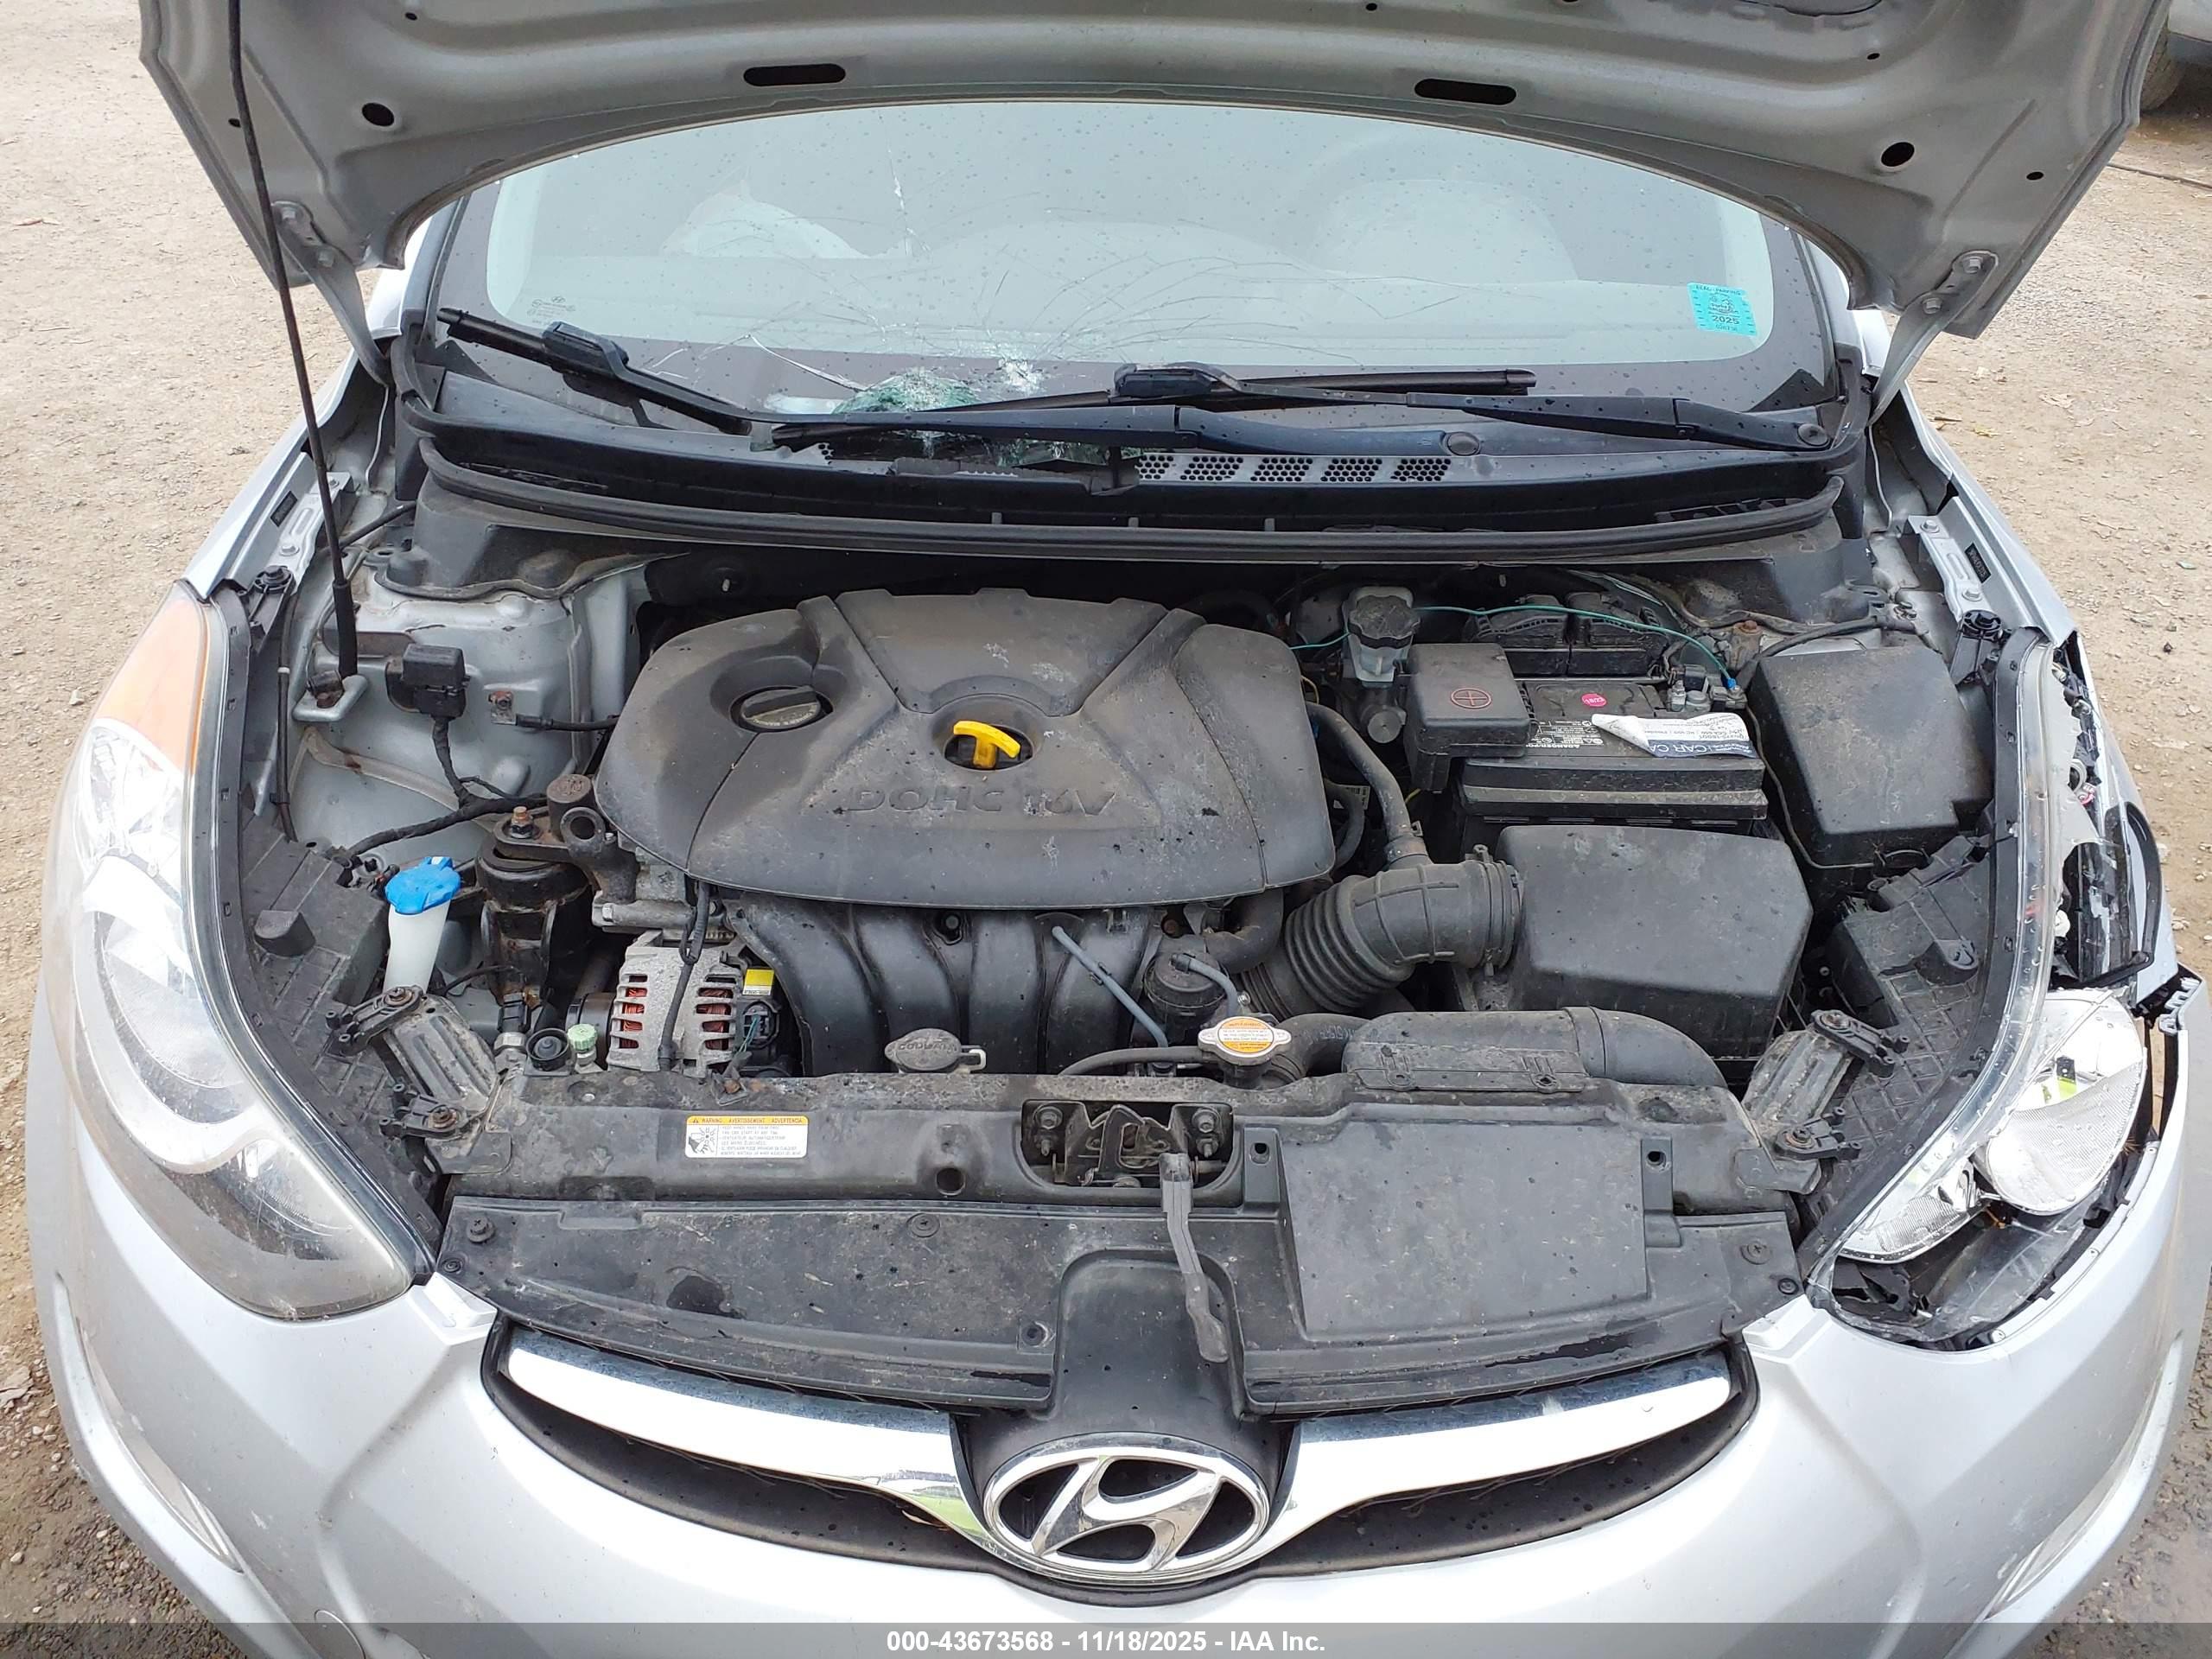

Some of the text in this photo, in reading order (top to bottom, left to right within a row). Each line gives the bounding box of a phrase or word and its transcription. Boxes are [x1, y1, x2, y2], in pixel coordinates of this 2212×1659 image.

[1712, 315, 1740, 325] 2025
[1673, 743, 1707, 753] CAR
[847, 787, 1004, 813] DOHC
